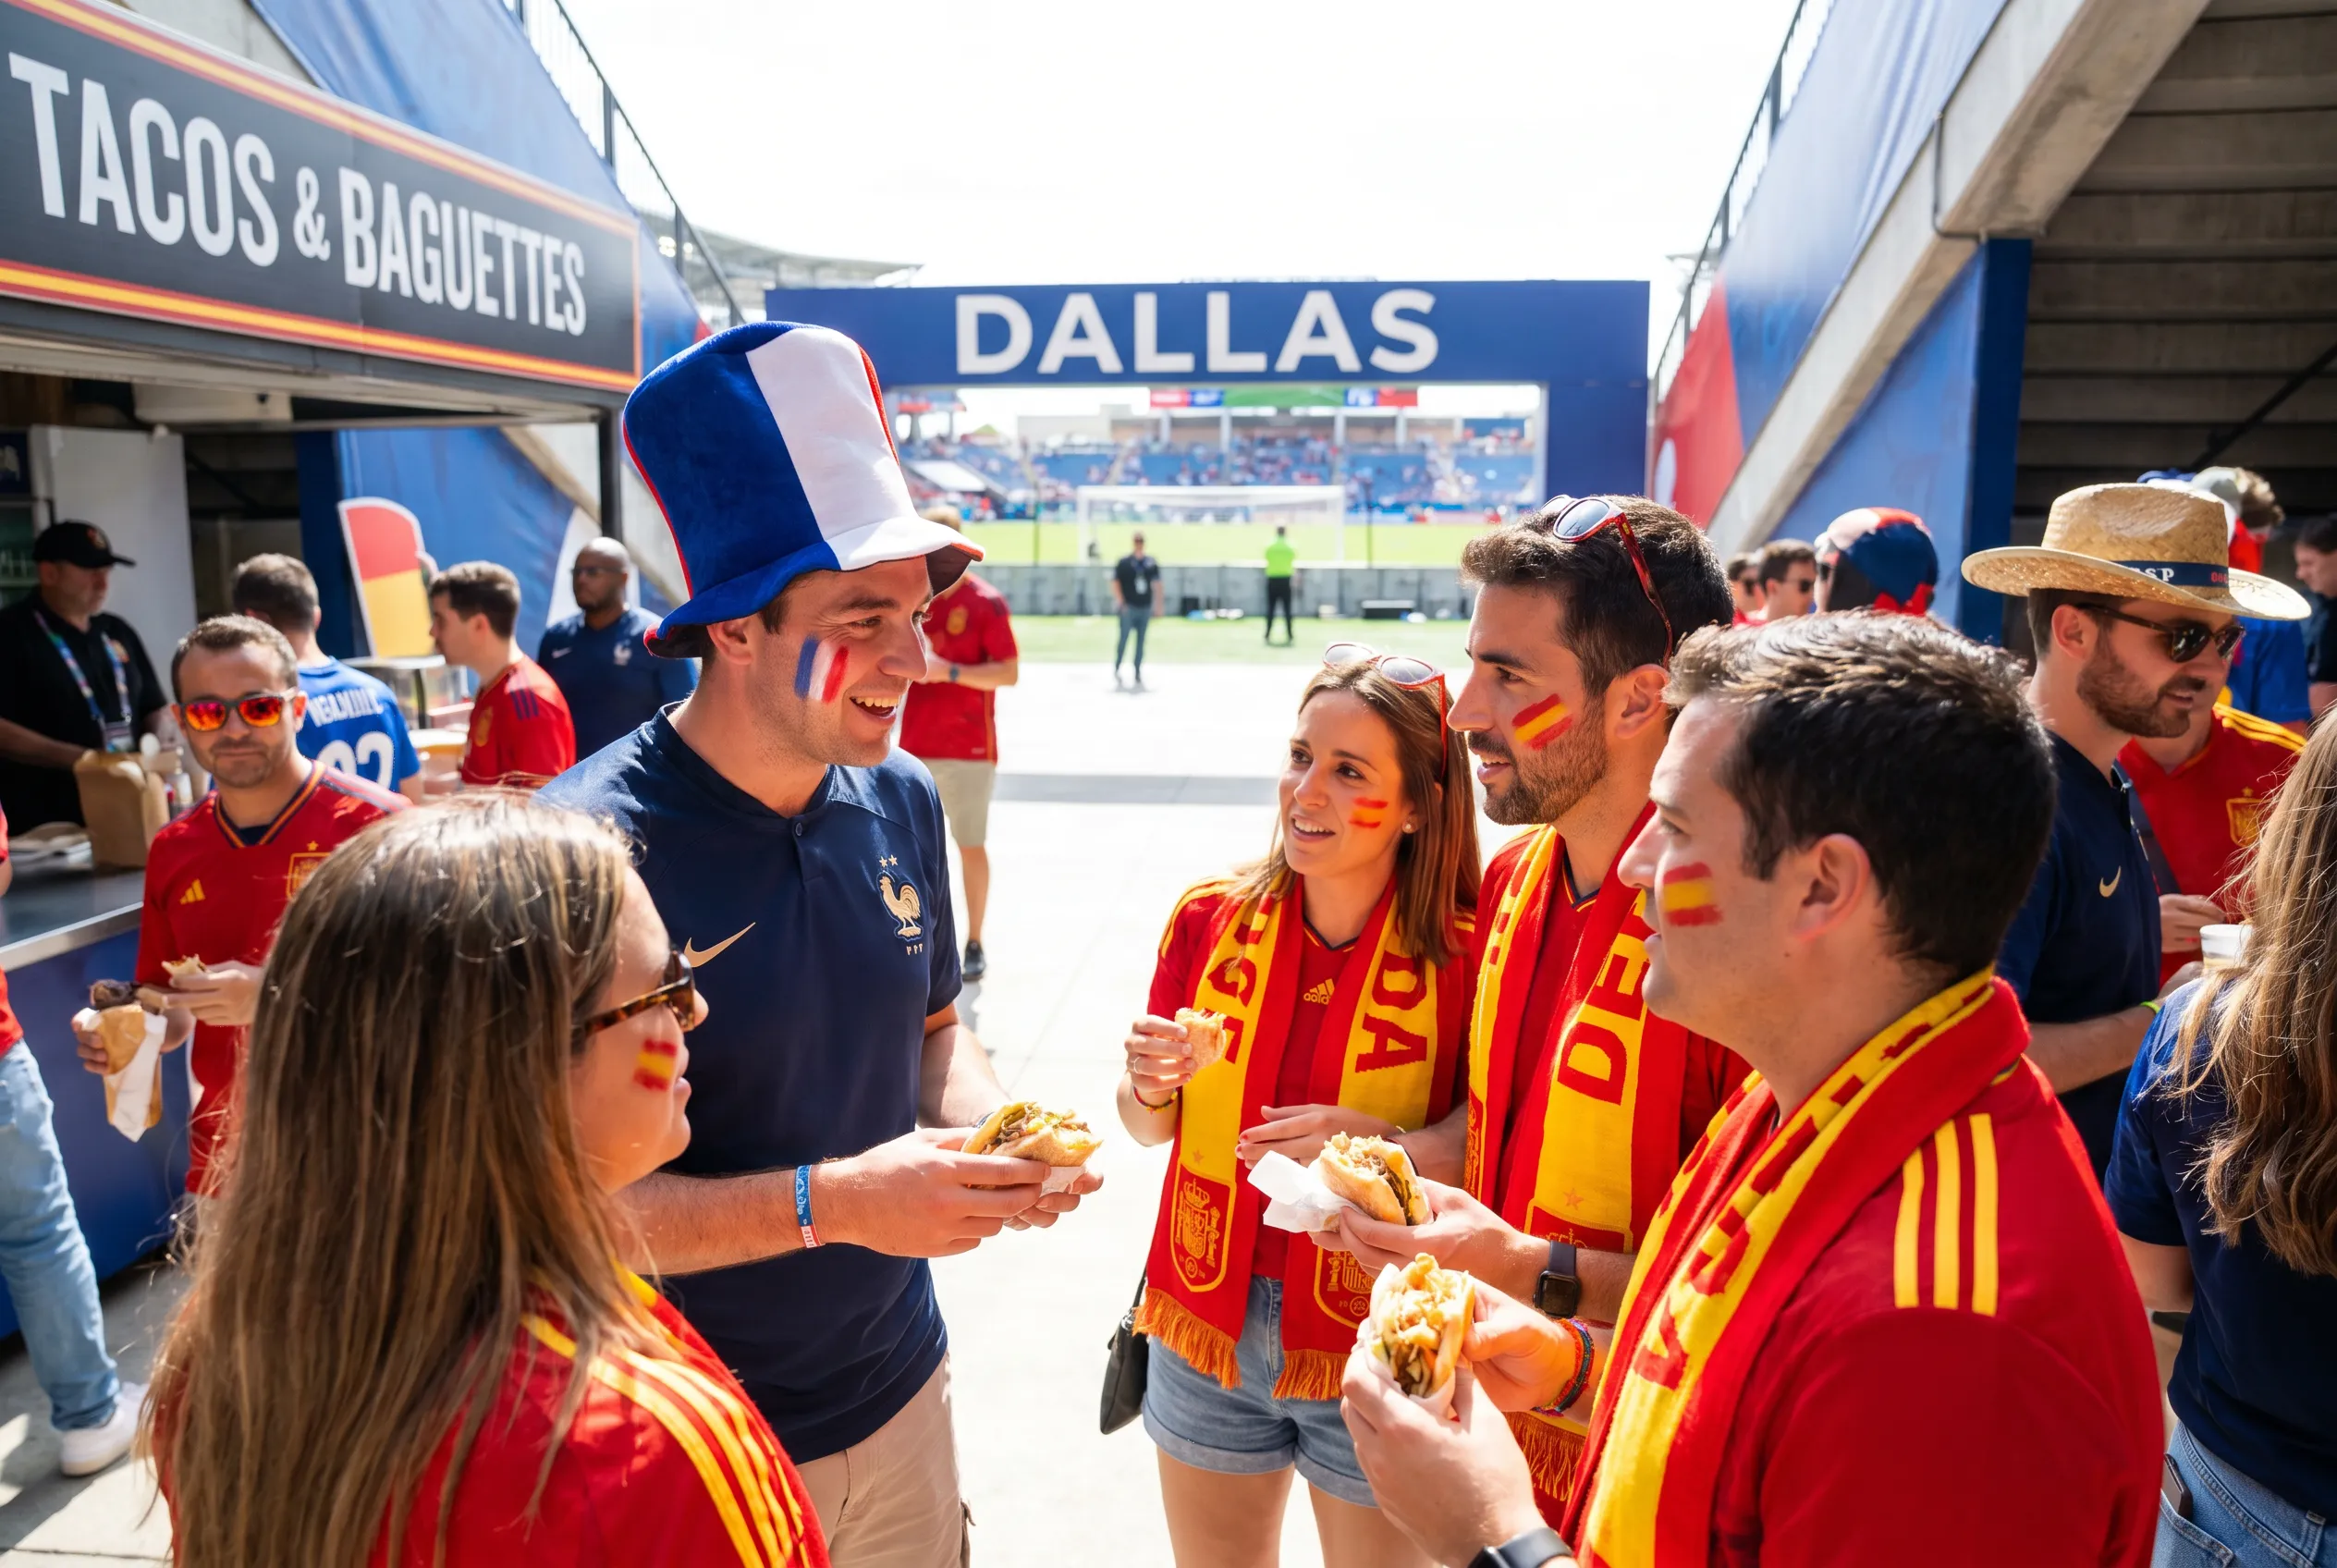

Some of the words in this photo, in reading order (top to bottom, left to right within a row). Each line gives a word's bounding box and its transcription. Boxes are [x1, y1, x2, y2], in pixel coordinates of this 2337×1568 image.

[9, 52, 280, 267] TACOS
[293, 166, 331, 262] &
[338, 166, 587, 337] BAGUETTES
[956, 288, 1439, 374] DALLAS
